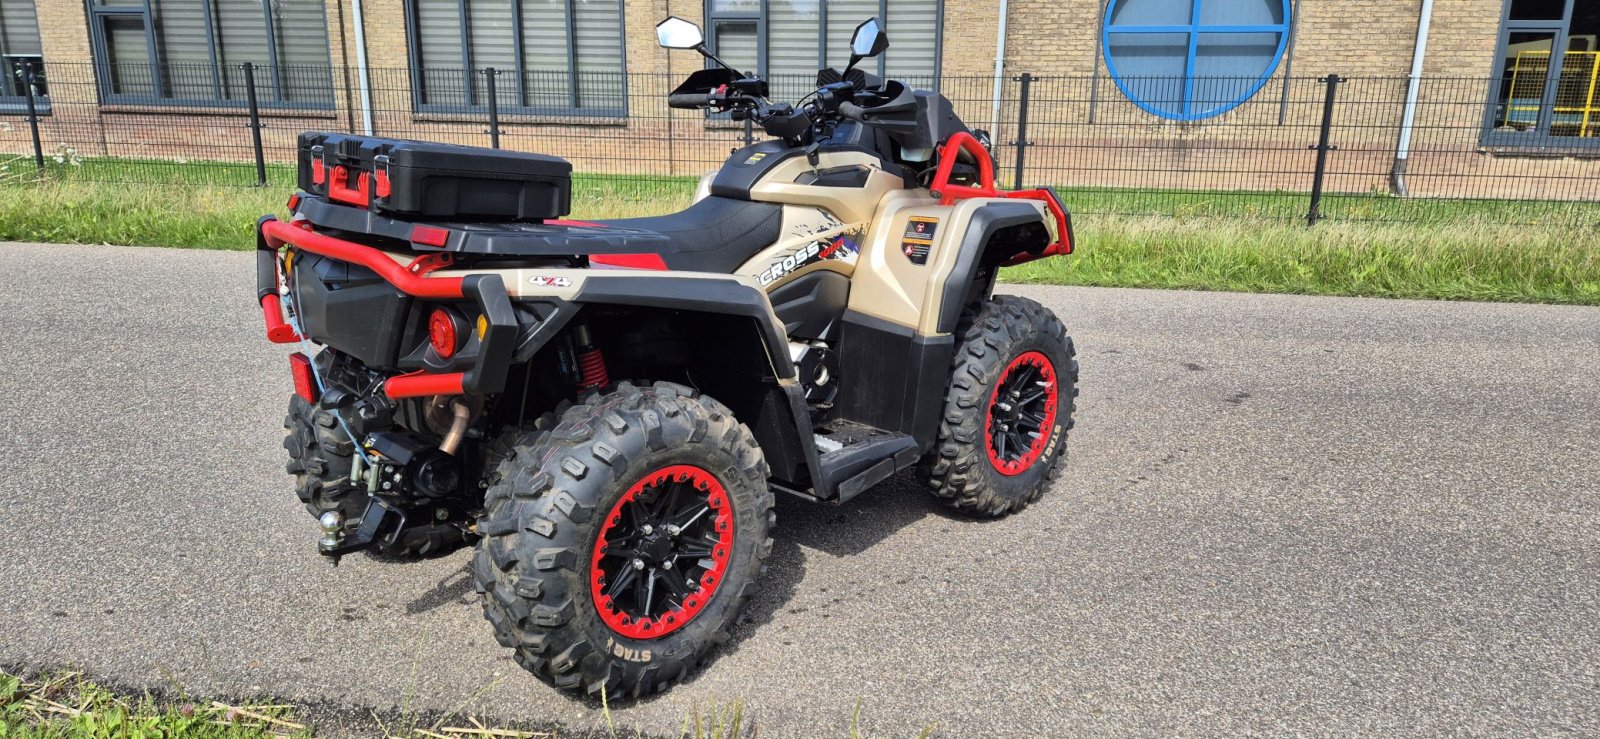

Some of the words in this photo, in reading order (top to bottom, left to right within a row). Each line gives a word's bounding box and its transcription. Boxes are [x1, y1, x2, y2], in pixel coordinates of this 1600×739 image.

[756, 240, 820, 286] CROSS
[1045, 424, 1061, 457] STAG
[613, 642, 651, 662] STAG
